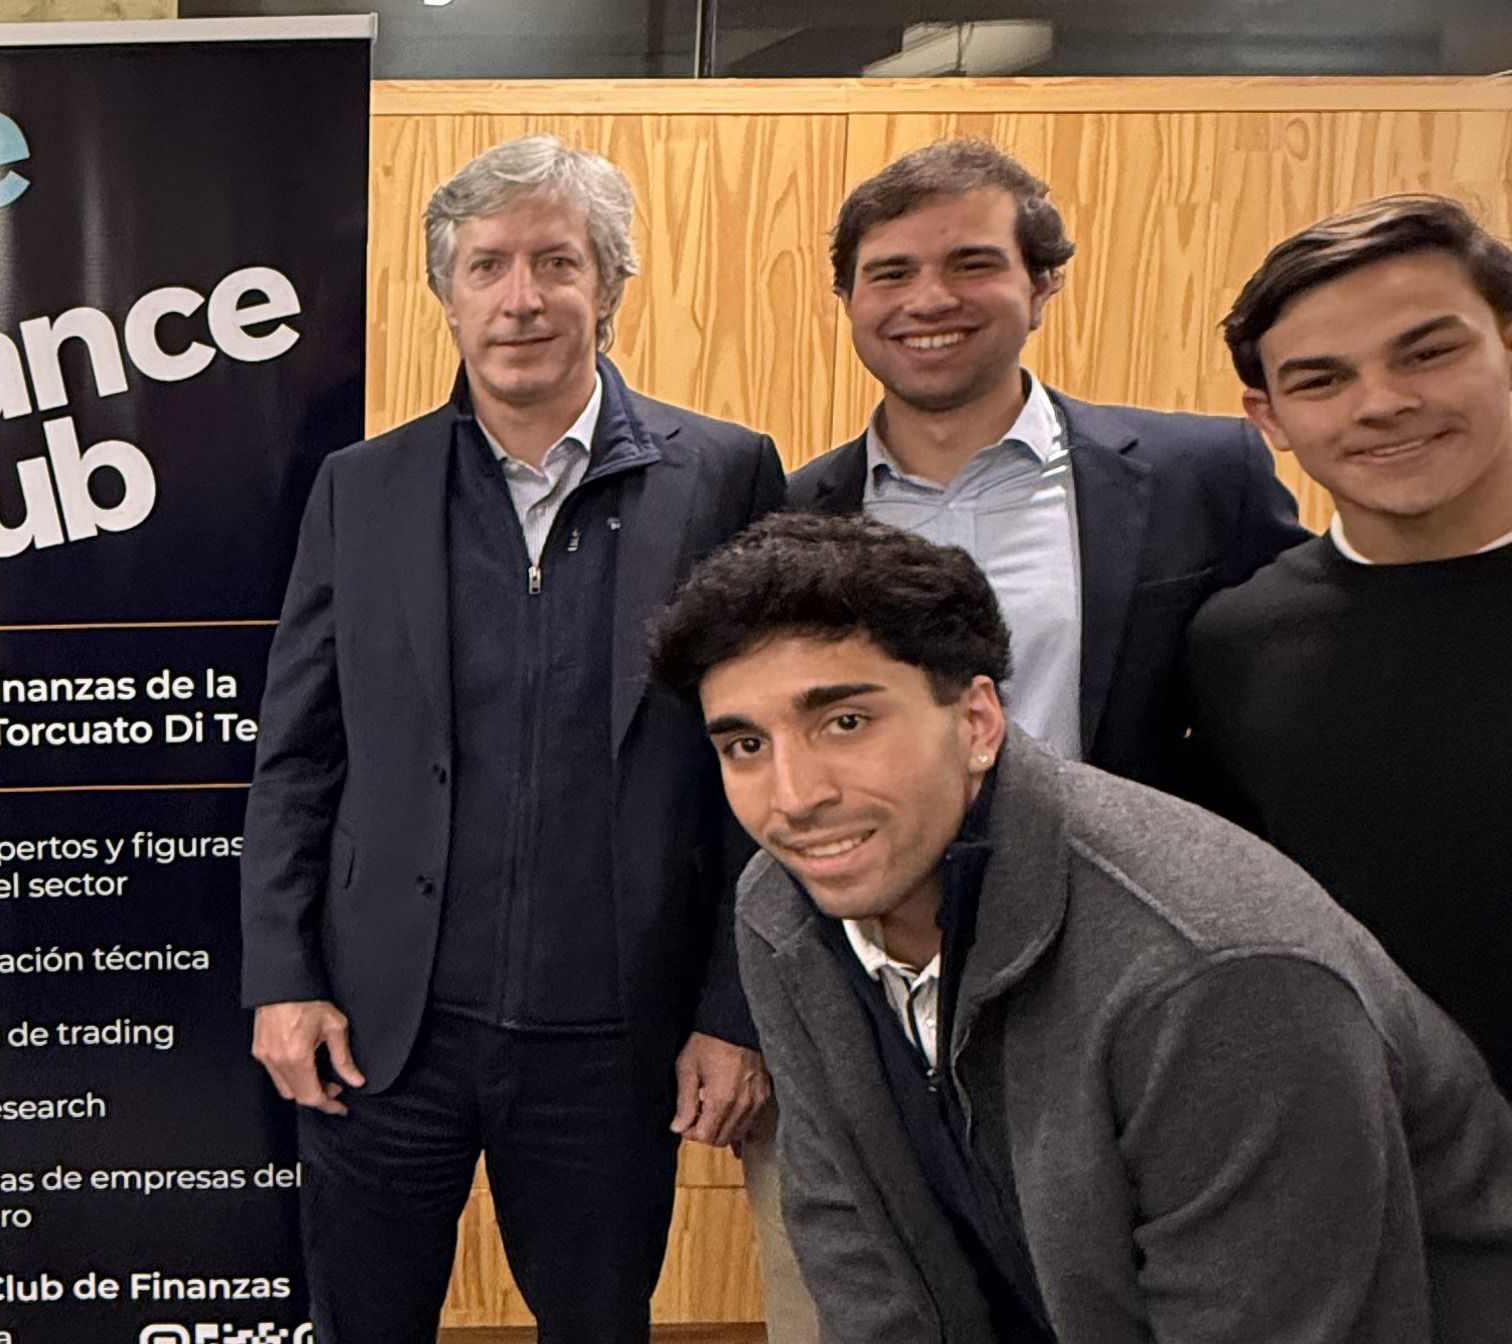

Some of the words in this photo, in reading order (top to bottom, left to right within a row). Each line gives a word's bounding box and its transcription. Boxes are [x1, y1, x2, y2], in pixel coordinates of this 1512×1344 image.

[146, 669, 194, 699] de
[207, 668, 236, 698] la
[166, 712, 203, 742] Di
[105, 839, 124, 864] y
[29, 874, 128, 897] sector
[92, 944, 209, 970] técnica
[8, 1021, 48, 1047] de
[56, 1019, 173, 1049] trading
[42, 1166, 82, 1190] de
[91, 1170, 246, 1194] empresas
[254, 1162, 301, 1187] del
[73, 1272, 119, 1299] de
[131, 1272, 290, 1299] Finanzas
